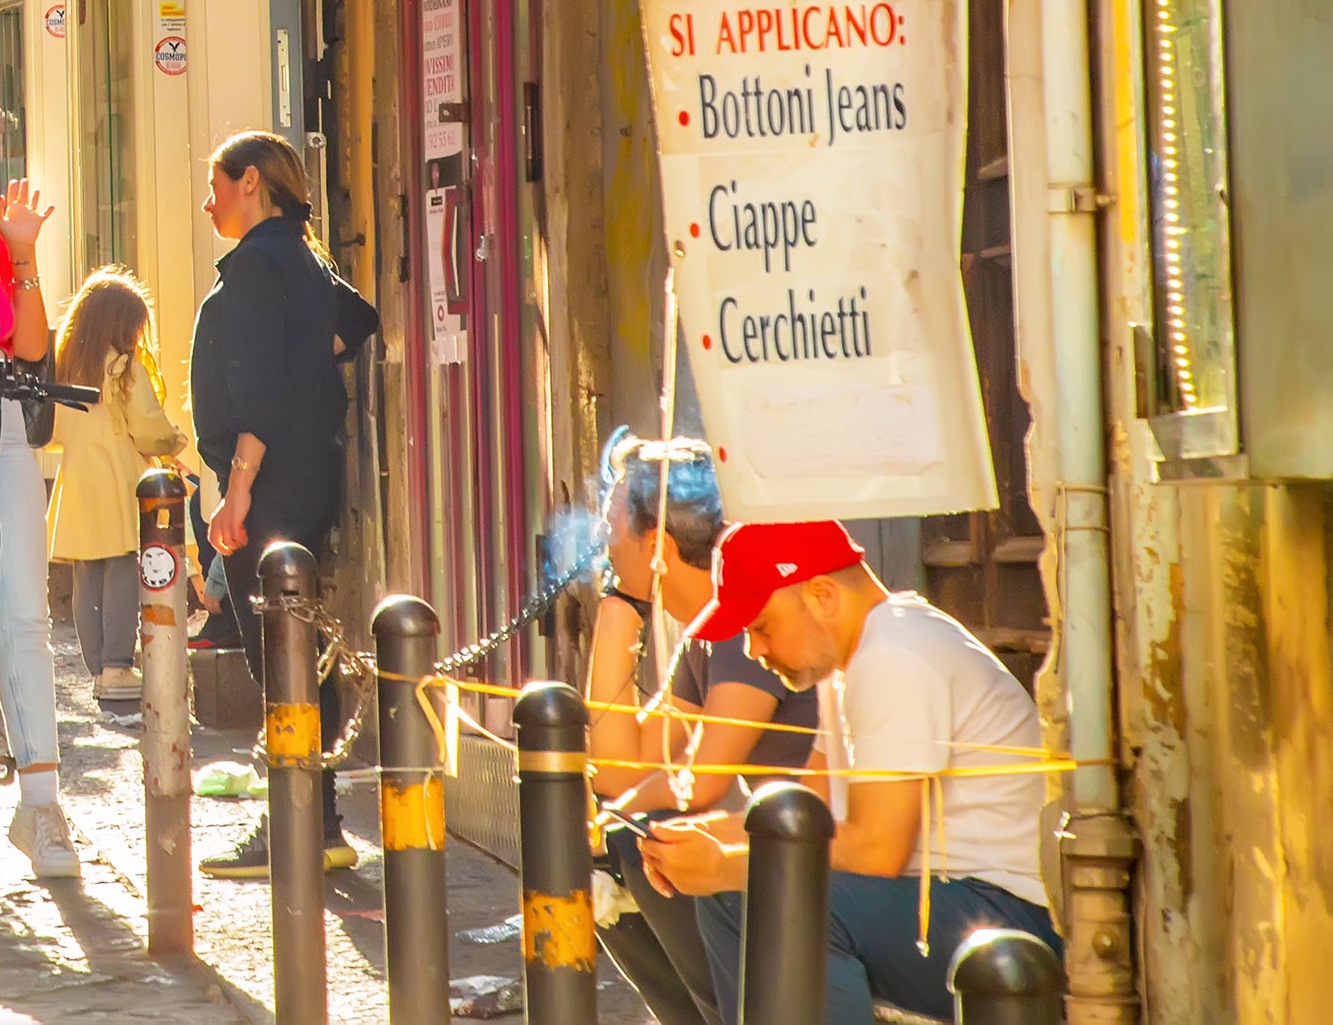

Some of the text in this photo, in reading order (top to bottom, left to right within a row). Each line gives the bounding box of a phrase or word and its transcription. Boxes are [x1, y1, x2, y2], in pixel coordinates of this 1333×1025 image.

[669, 2, 907, 58] SI APPLICANO:
[698, 63, 907, 147] Bottoni Jeans
[709, 179, 818, 273] Ciappe
[719, 285, 872, 364] Cerchietti
